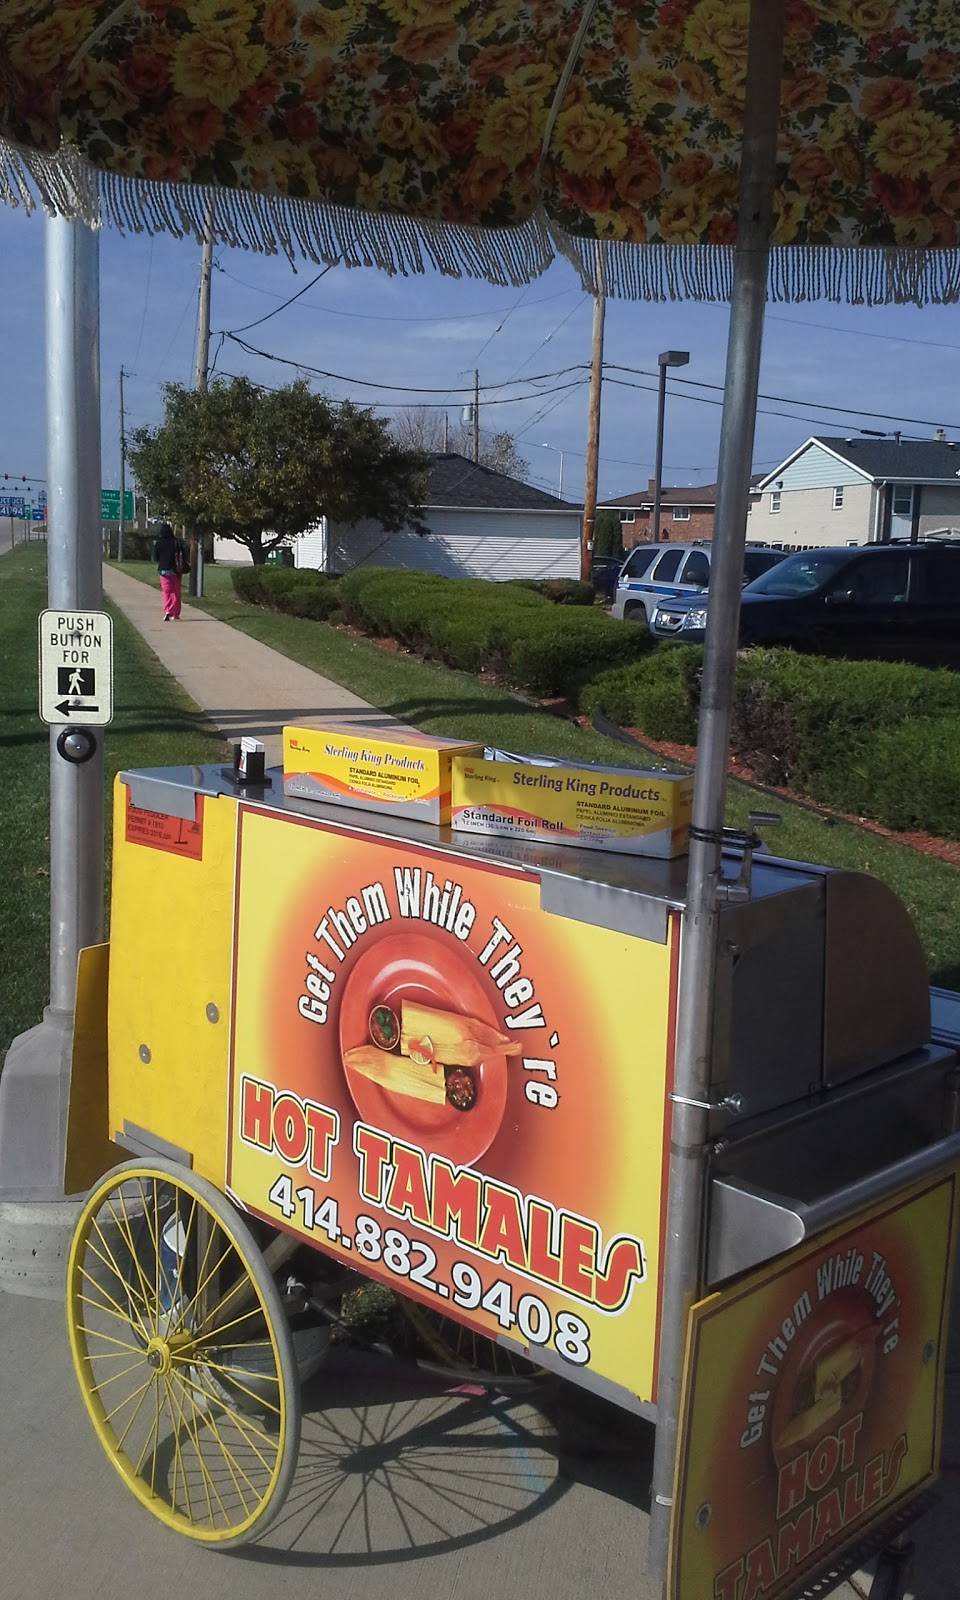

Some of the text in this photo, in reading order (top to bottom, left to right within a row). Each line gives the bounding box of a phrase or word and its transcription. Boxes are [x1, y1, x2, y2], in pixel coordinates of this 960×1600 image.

[57, 616, 95, 632] PUSH
[50, 634, 102, 648] BUTTON
[62, 650, 90, 664] FOR
[324, 743, 359, 763] Sterling
[361, 750, 383, 767] King
[384, 753, 426, 771] Products
[349, 767, 377, 778] STANDARD
[407, 776, 420, 785] FOIL
[464, 773, 484, 782] Sterling
[512, 771, 564, 793] Sterling
[566, 778, 597, 796] King
[600, 781, 660, 801] Products
[463, 809, 564, 832] Standard Foil Roll
[576, 801, 666, 817] STANDARD ALUMINUM FOIL
[470, 820, 485, 828] INCH
[393, 866, 478, 940] While
[314, 880, 392, 965] Them
[298, 948, 338, 1026] Get
[238, 1075, 648, 1314] HOT TAMALES
[268, 1175, 592, 1365] 414.882.9408
[740, 1389, 771, 1449] Get
[756, 1290, 812, 1378] Them
[816, 1248, 865, 1301] While
[776, 1411, 864, 1520] HOT
[713, 1433, 909, 1600] TAMALES
